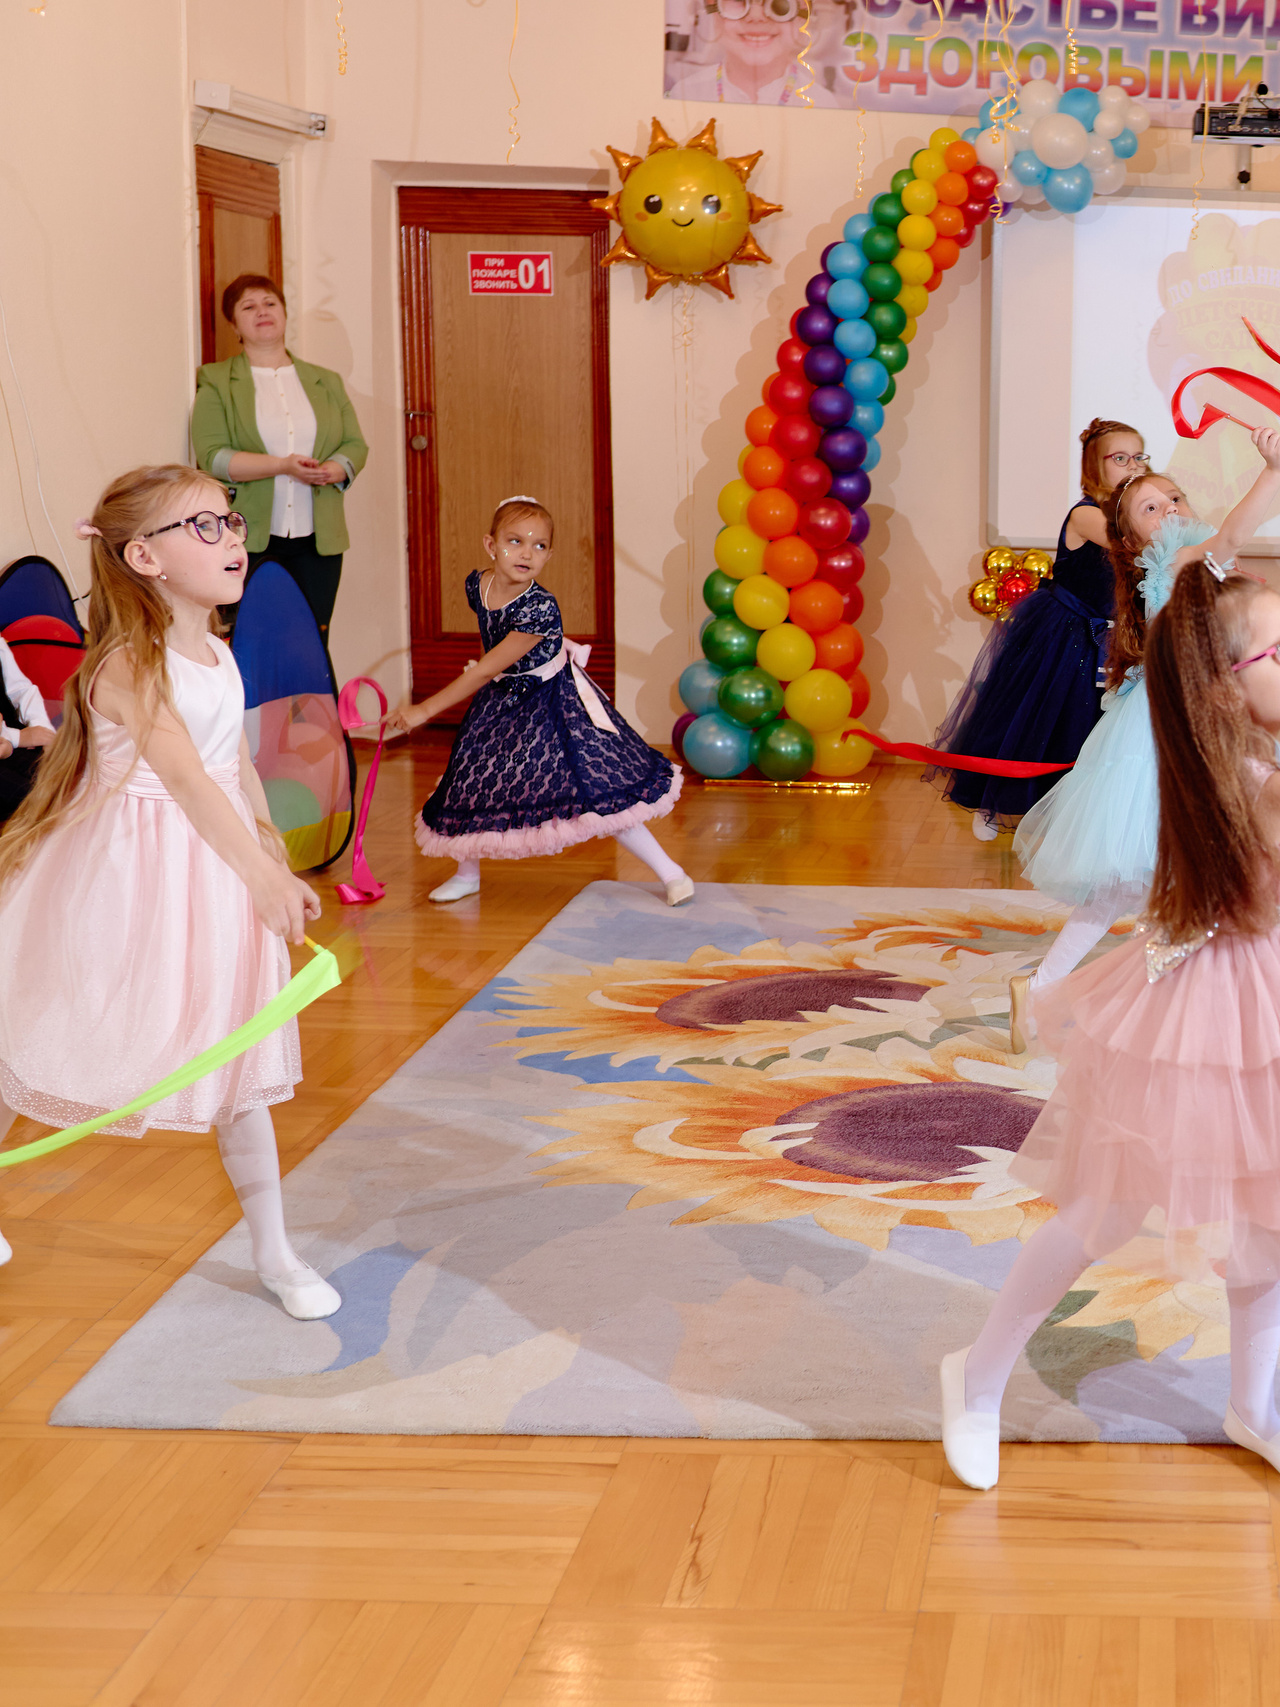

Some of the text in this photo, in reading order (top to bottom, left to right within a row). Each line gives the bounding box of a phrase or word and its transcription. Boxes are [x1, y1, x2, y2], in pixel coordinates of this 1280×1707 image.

[863, 0, 1158, 35] СТЬЕ
[841, 31, 1265, 104] ЗДОРОВЫМИ
[472, 268, 518, 278] ПОЖАРЕ
[484, 257, 505, 267] ПРИ
[517, 258, 551, 290] 01
[473, 279, 518, 290] ЗВОНИТЬ
[1167, 279, 1193, 308] ДО
